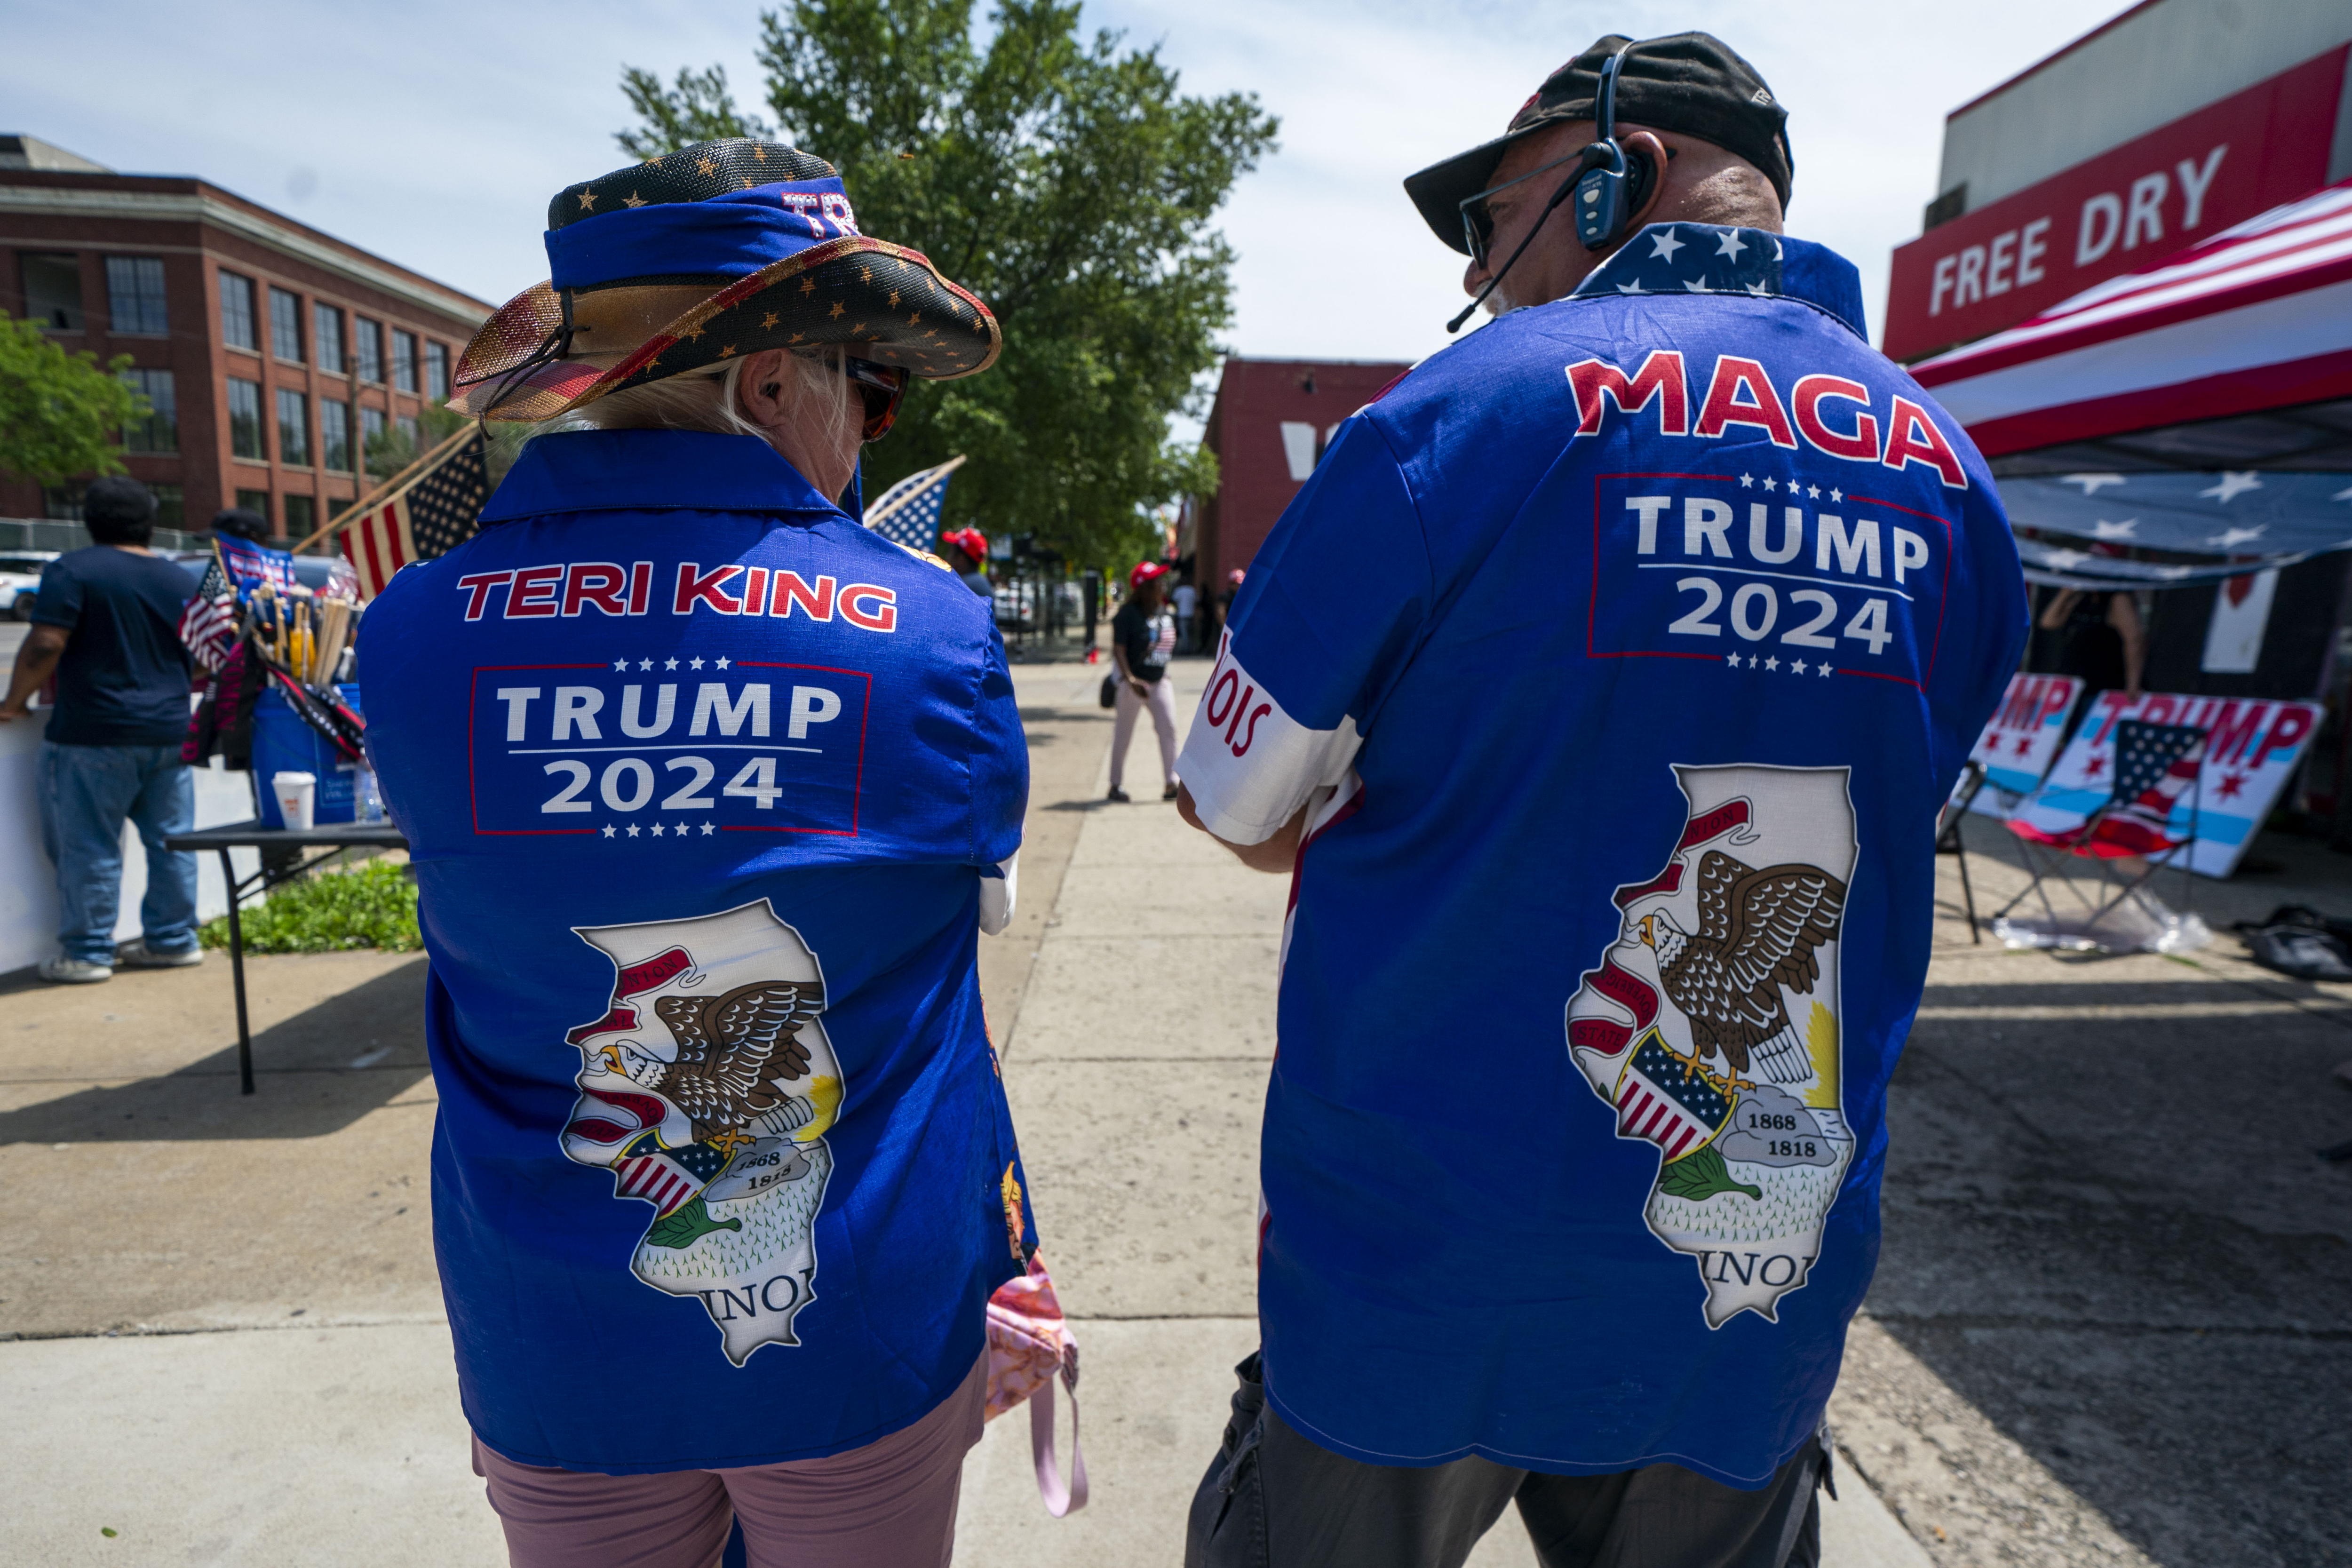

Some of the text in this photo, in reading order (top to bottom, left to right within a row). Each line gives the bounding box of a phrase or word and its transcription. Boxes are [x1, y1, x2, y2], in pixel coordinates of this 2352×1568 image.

[1929, 143, 2227, 317] FREE DRY
[1565, 350, 1968, 490] MAGA
[1625, 496, 1929, 585] TRUMP
[456, 561, 897, 632] TERI KING
[1669, 577, 1893, 655] 2024
[497, 682, 842, 741] TRUMP
[1989, 677, 2072, 731] MP
[541, 756, 782, 813] 2024
[1688, 809, 1734, 840] NION
[1577, 1026, 1622, 1047] STATE
[1749, 1113, 1796, 1130] 1868
[1769, 1140, 1816, 1157] 1818
[736, 1152, 780, 1171] 1868
[748, 1164, 791, 1190] 1818
